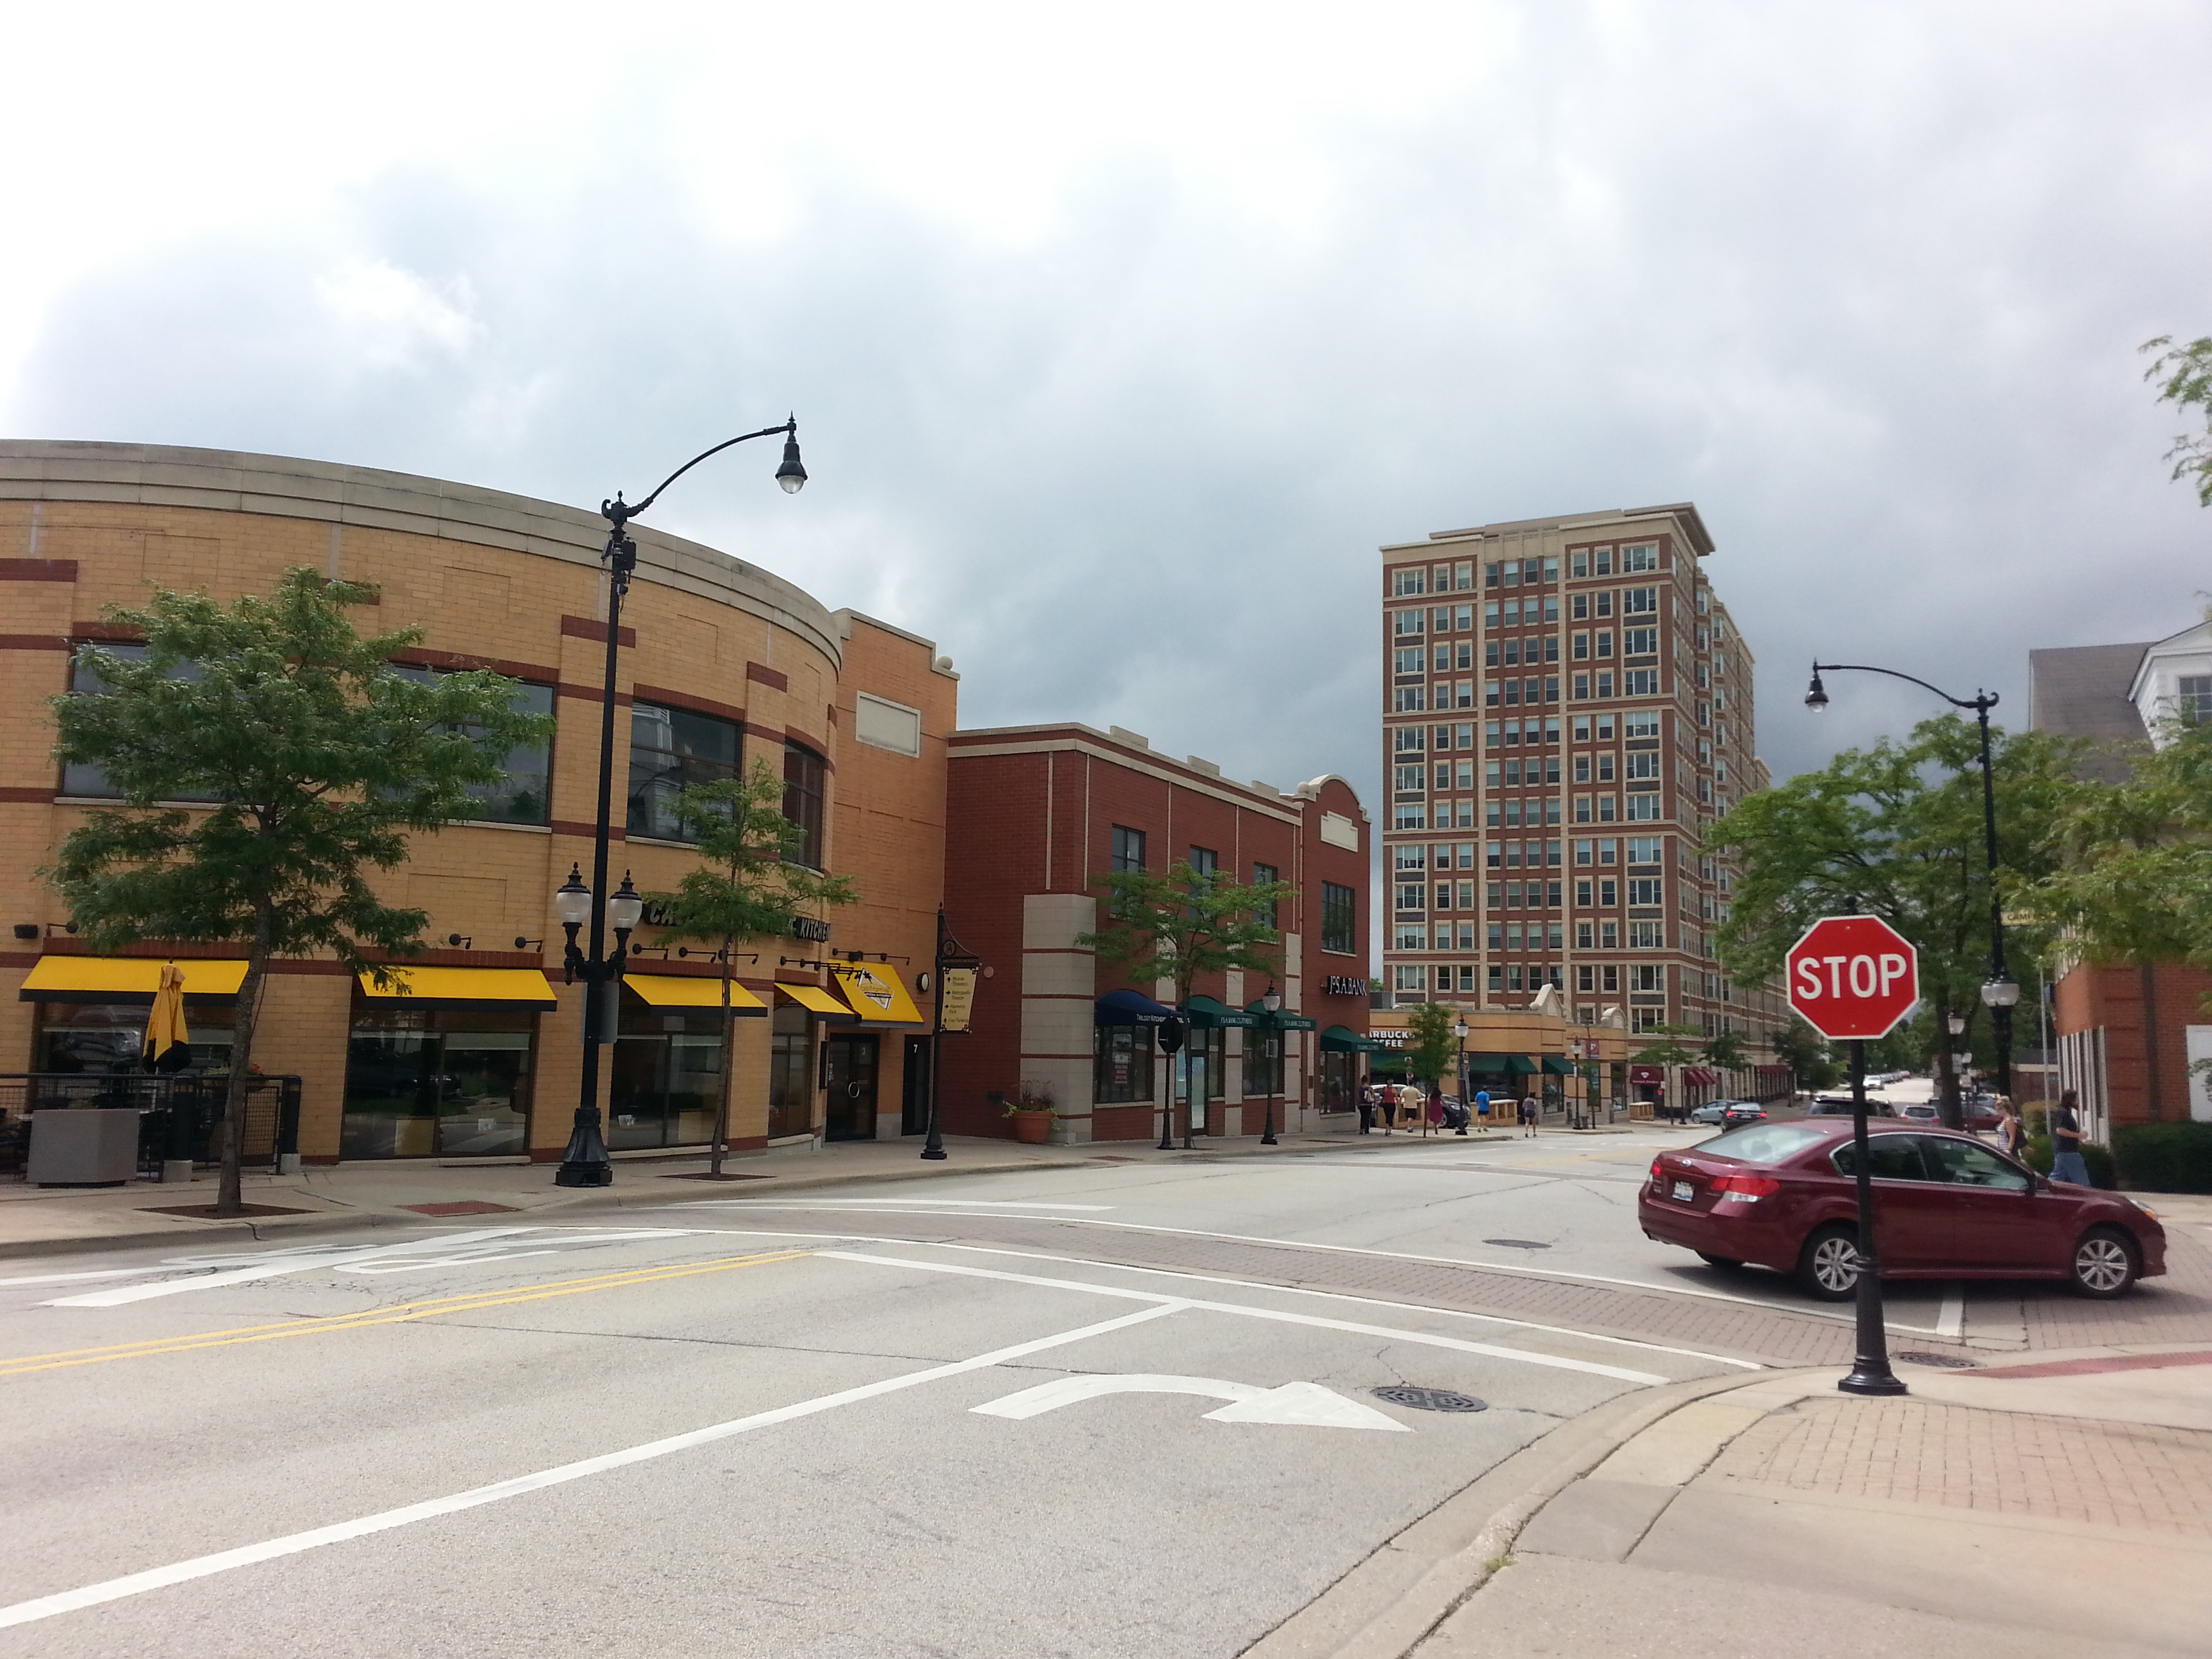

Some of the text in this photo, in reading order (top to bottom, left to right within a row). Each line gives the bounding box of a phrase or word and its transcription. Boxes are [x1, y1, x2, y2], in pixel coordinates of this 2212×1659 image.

[800, 918, 830, 941] KITCHEN
[1797, 954, 1907, 1000] STOP
[914, 1044, 918, 1052] 7
